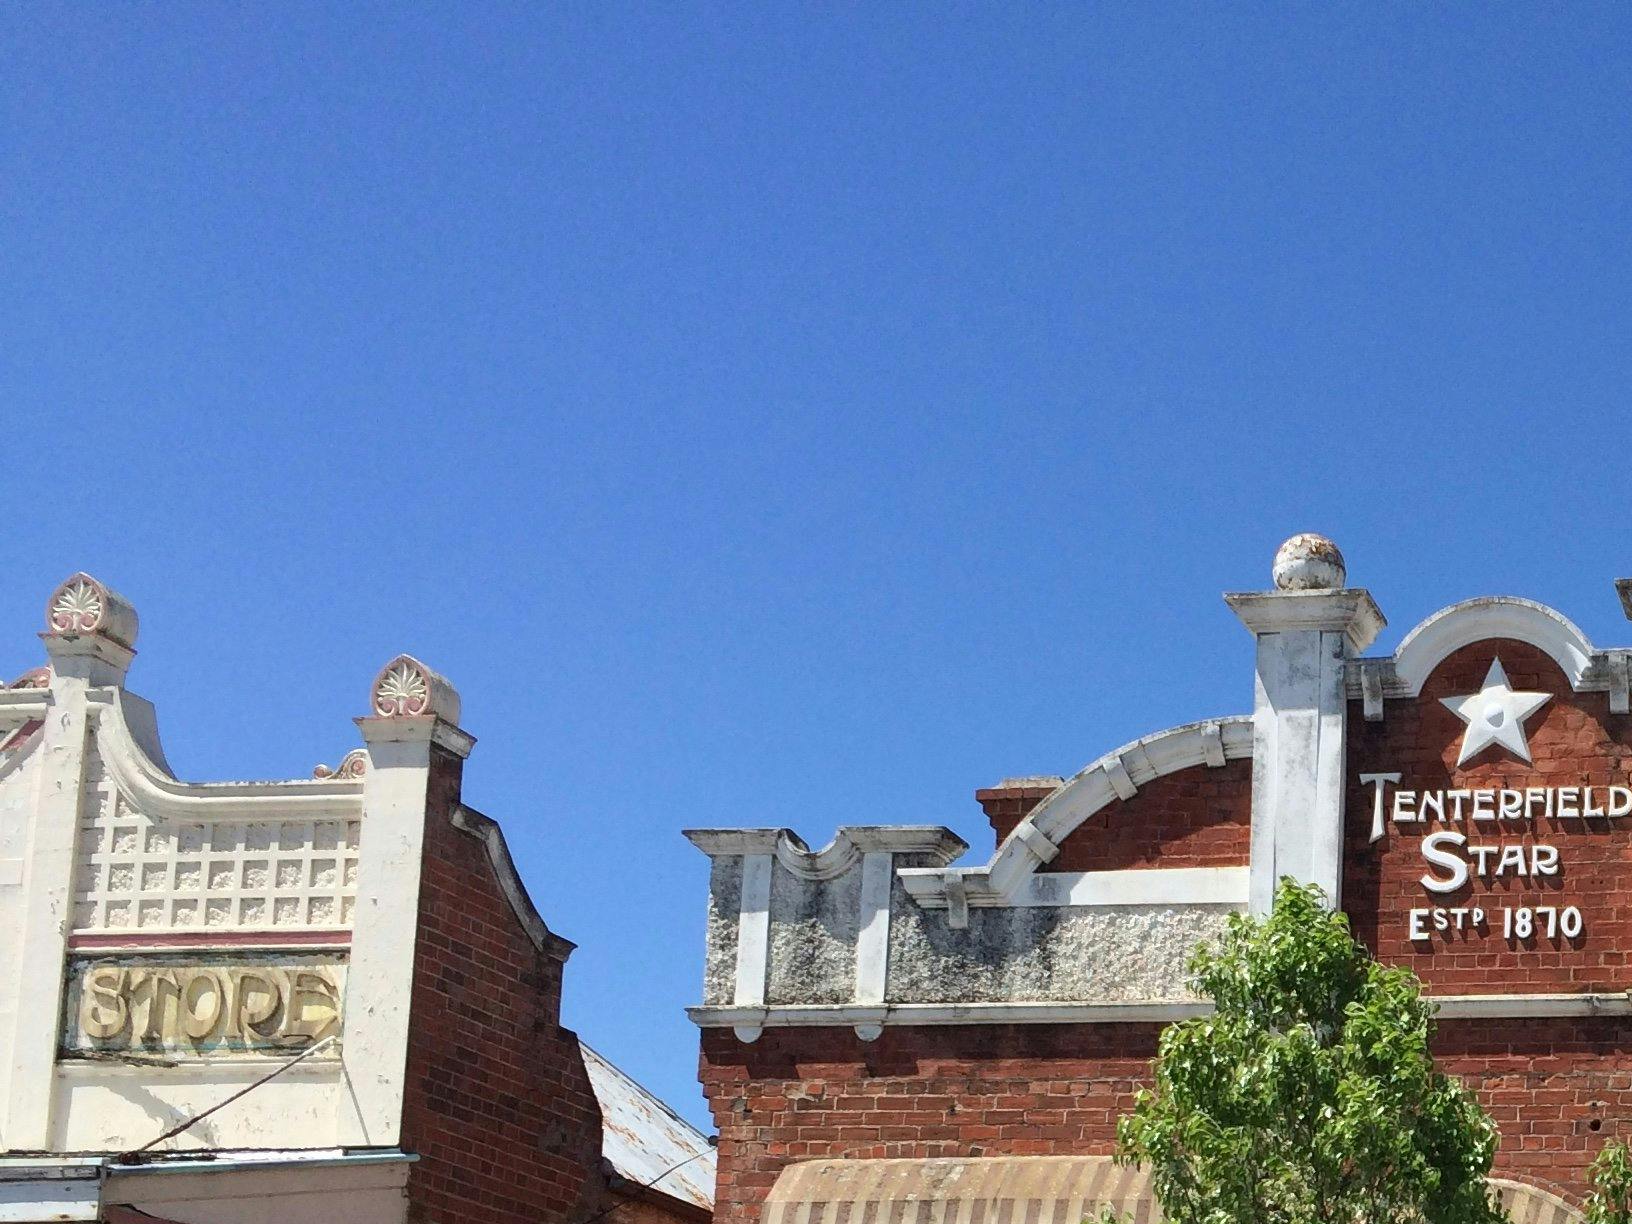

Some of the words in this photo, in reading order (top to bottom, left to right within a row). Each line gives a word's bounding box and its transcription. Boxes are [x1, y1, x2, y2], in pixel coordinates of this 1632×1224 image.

[1420, 831, 1559, 893] STAR
[1504, 906, 1582, 939] 1870
[84, 967, 342, 1045] STORE
